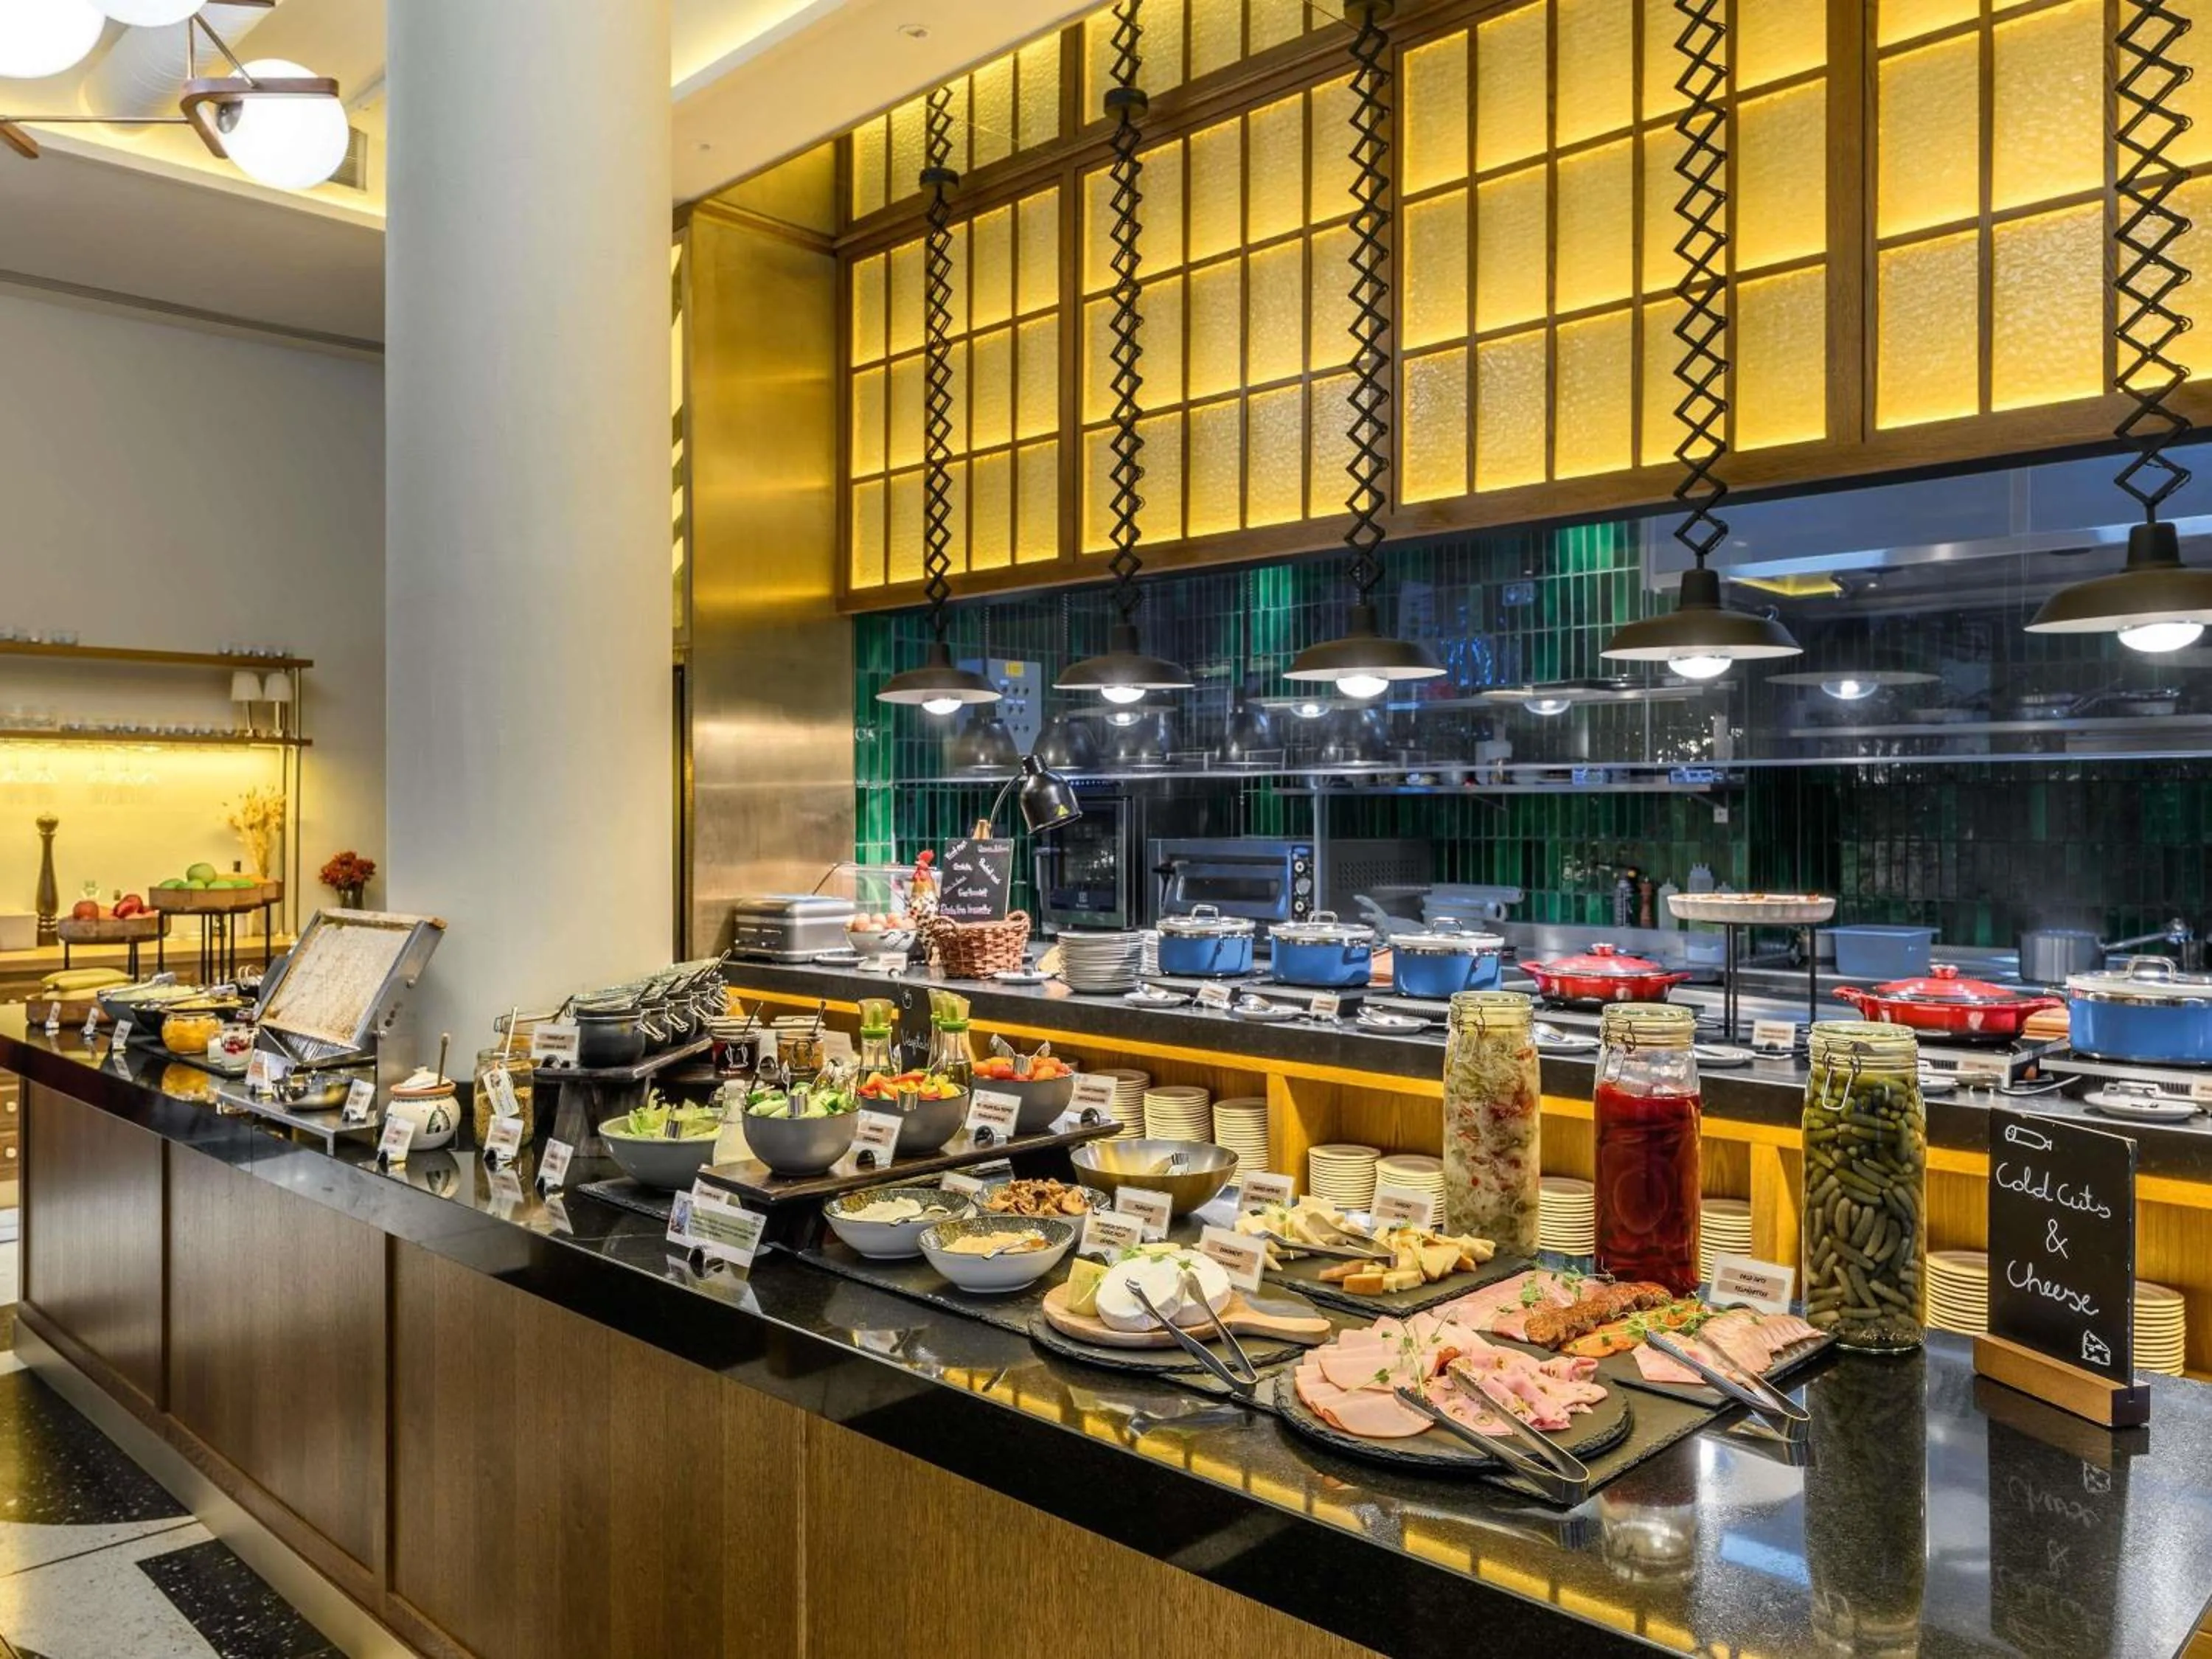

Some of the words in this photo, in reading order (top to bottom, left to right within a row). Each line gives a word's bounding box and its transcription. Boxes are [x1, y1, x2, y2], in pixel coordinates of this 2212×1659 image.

[1996, 1162, 2053, 1201] Cold
[2057, 1183, 2111, 1218] Cuts
[2046, 1218, 2067, 1259] &
[2006, 1259, 2099, 1315] Cheese
